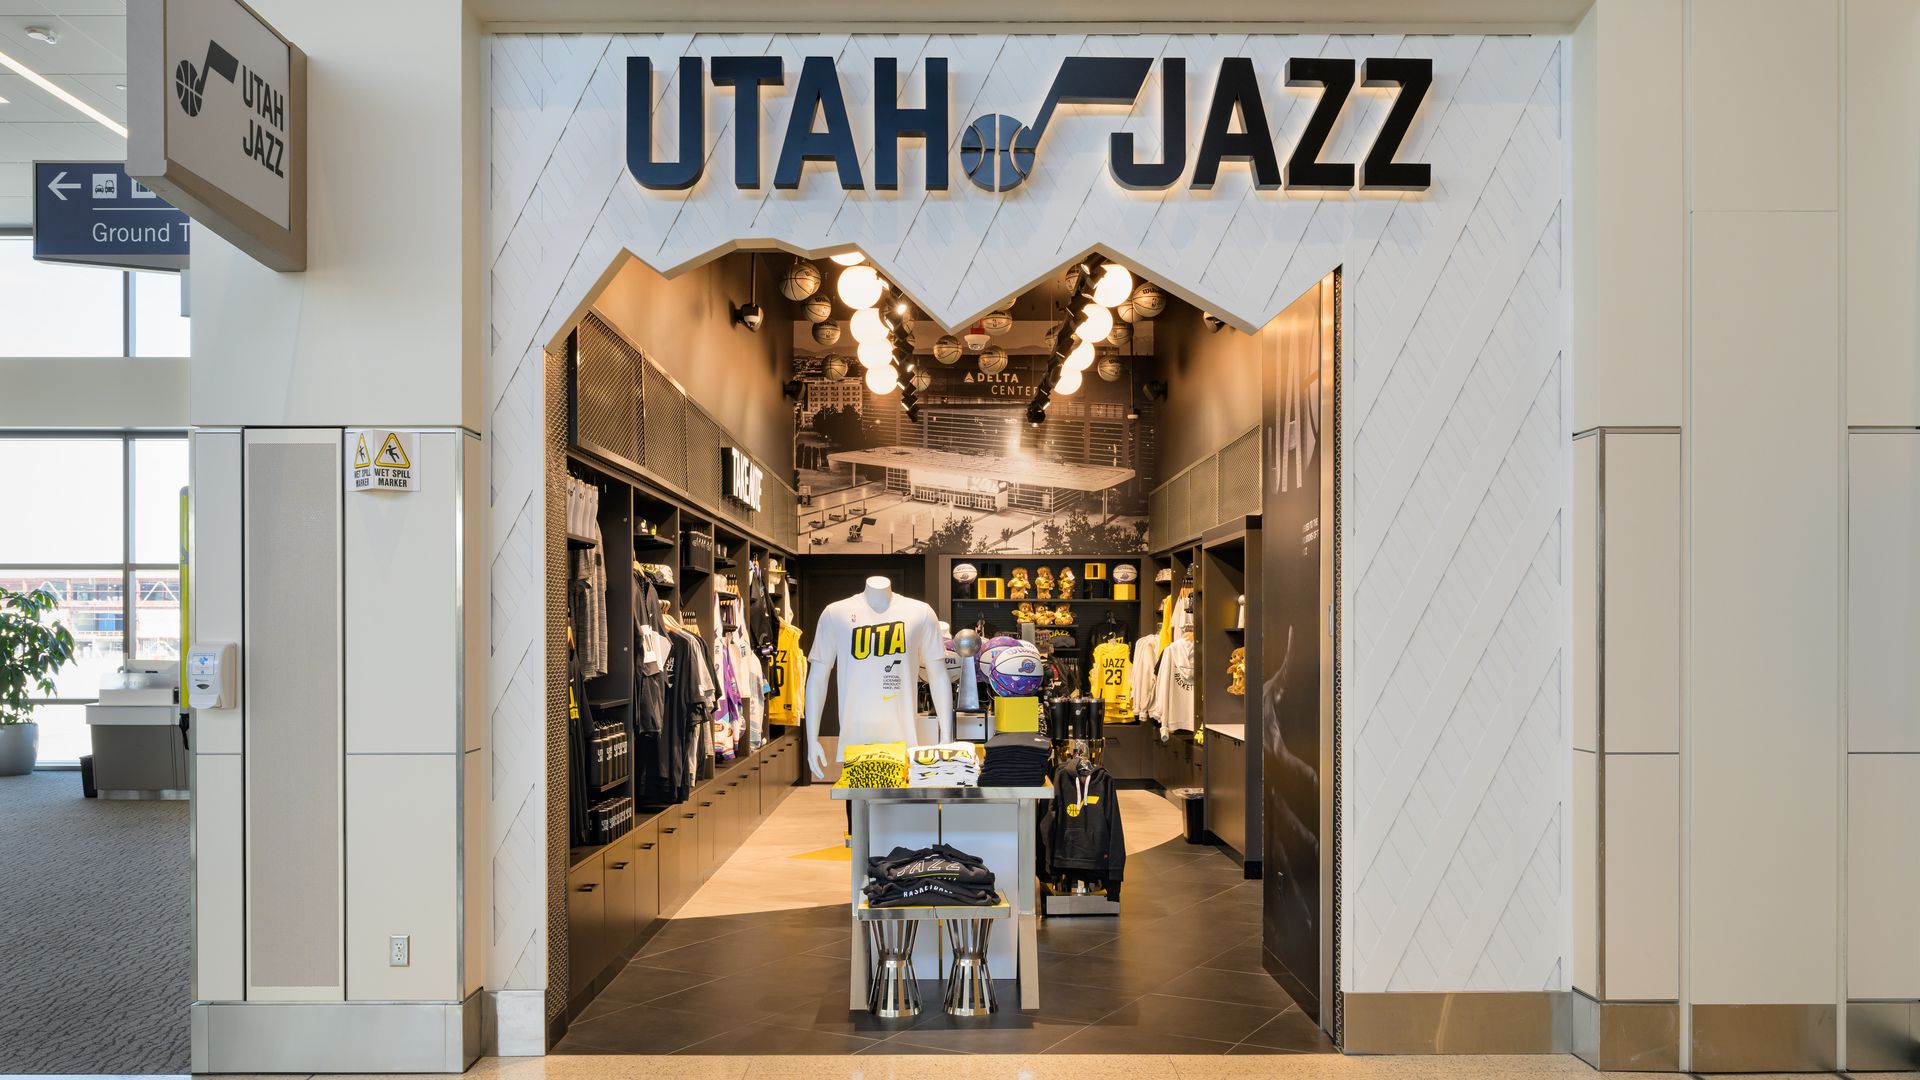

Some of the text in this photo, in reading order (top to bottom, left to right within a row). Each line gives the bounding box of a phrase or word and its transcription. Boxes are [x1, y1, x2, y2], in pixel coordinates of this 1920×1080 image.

[243, 65, 284, 132] UTAH
[625, 56, 1434, 191] UTAH JAZZ
[243, 118, 284, 179] JAZZ
[92, 222, 171, 243] Ground
[977, 372, 1020, 384] DELTA
[374, 468, 411, 479] WET SPILL
[378, 478, 407, 487] MARKER
[851, 621, 906, 660] UTA
[1102, 658, 1126, 669] JAZZ
[1105, 669, 1123, 686] 23
[914, 748, 973, 766] UTA
[896, 858, 961, 877] JAZZ
